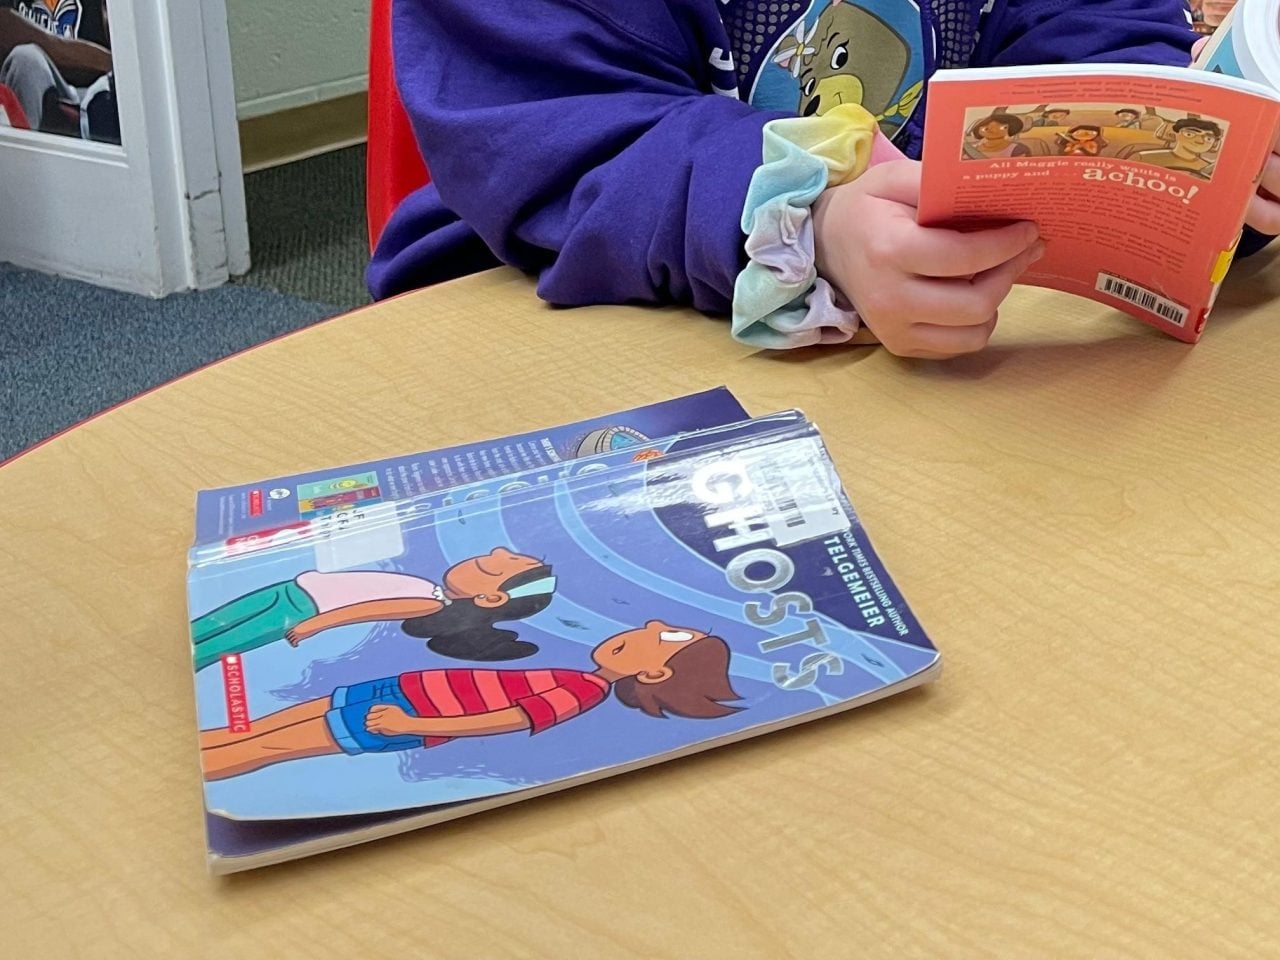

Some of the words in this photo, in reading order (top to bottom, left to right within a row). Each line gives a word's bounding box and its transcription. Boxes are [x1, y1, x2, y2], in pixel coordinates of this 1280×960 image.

[975, 171, 1019, 181] puppy
[1082, 167, 1200, 205] achoo!
[990, 161, 1011, 169] All
[1016, 159, 1069, 169] Maggie
[1074, 159, 1114, 170] really
[1119, 165, 1161, 178] wants
[1164, 173, 1177, 182] is
[692, 461, 845, 691] GHOSTS
[823, 536, 886, 628] TELGEMEIER
[862, 564, 892, 608] BESTSELLING
[885, 605, 910, 638] AUTHOR
[226, 664, 246, 732] SCHOLASTIC
